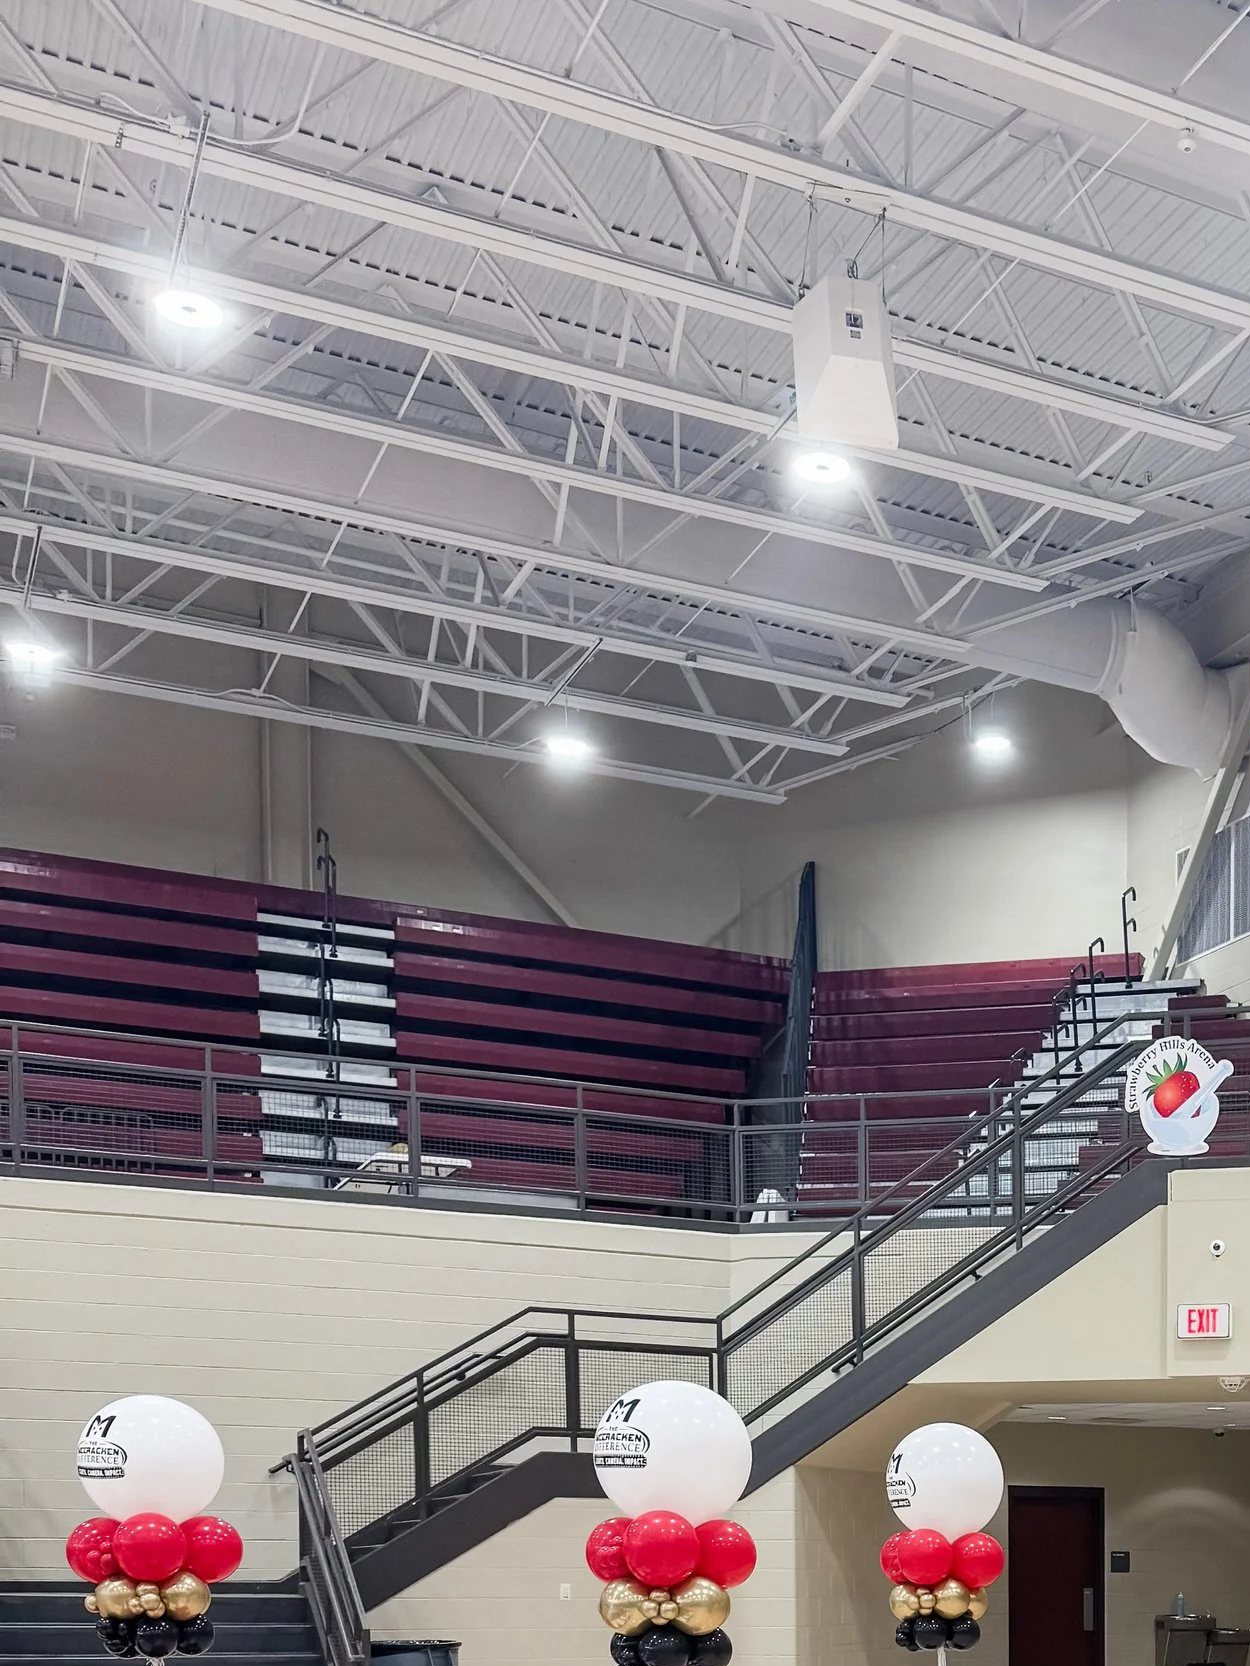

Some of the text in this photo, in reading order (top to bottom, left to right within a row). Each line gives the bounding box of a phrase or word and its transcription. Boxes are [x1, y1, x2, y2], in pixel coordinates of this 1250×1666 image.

[1128, 1039, 1216, 1110] Strawberry Hills Arena
[1187, 1307, 1220, 1334] EXIT
